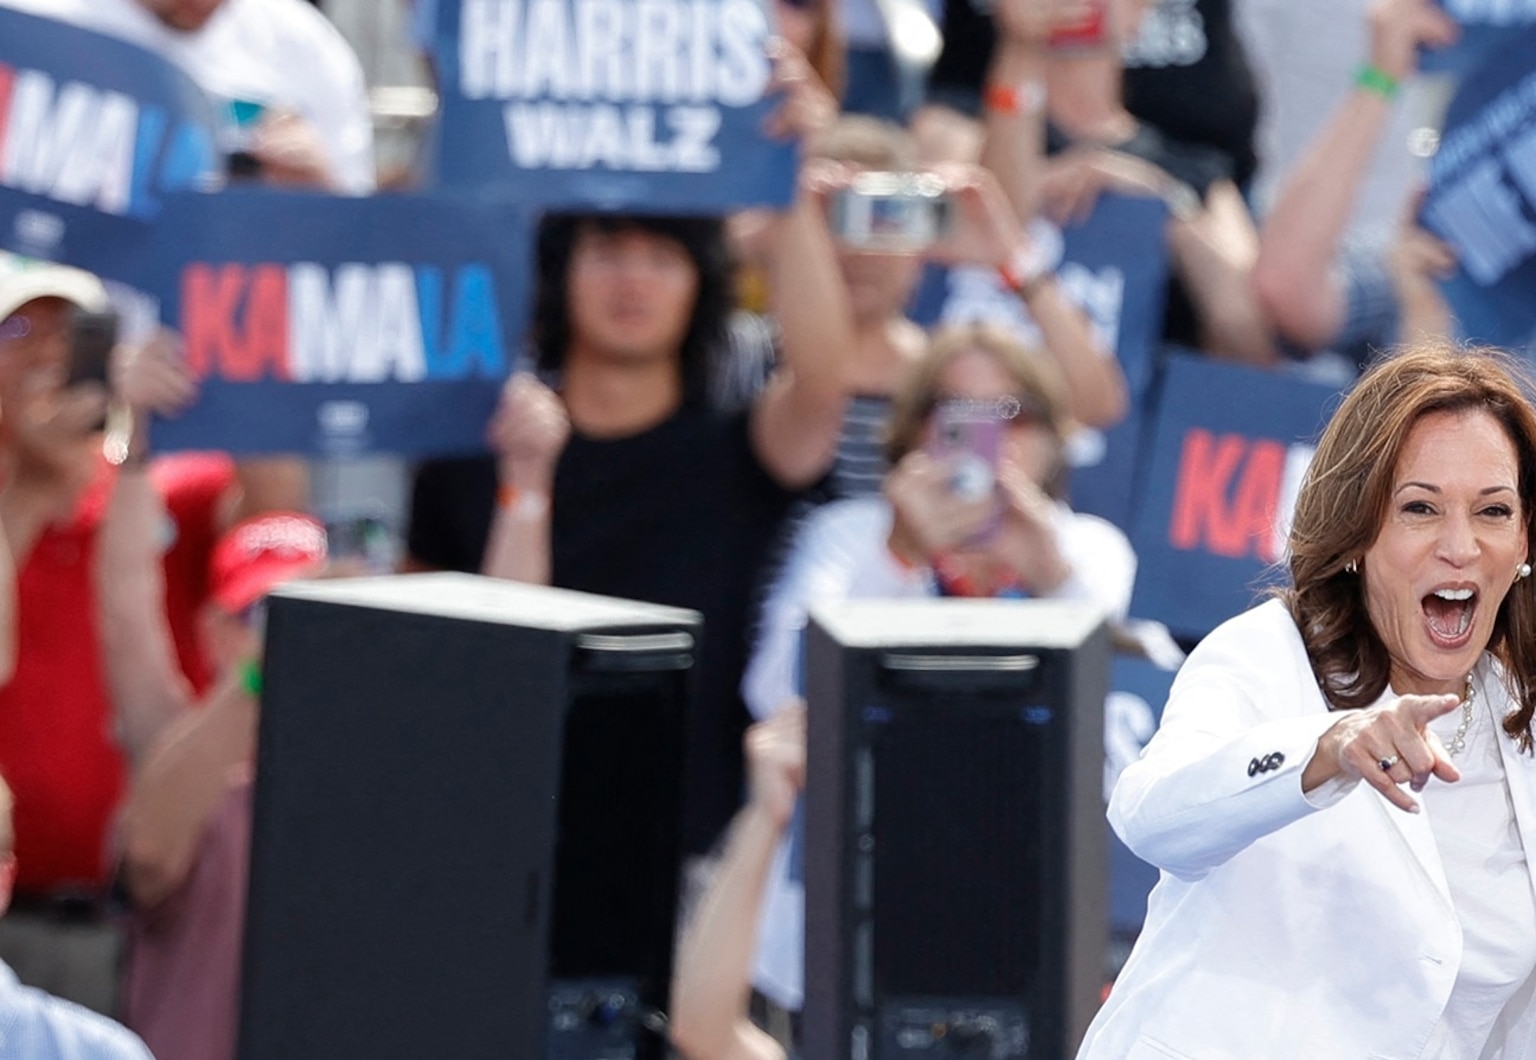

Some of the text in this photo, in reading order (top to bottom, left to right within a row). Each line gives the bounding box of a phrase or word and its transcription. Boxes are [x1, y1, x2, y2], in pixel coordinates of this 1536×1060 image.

[459, 0, 771, 106] HARRIS
[0, 62, 214, 222] MALA
[504, 101, 722, 173] WALZ
[181, 260, 503, 385] KAMALA
